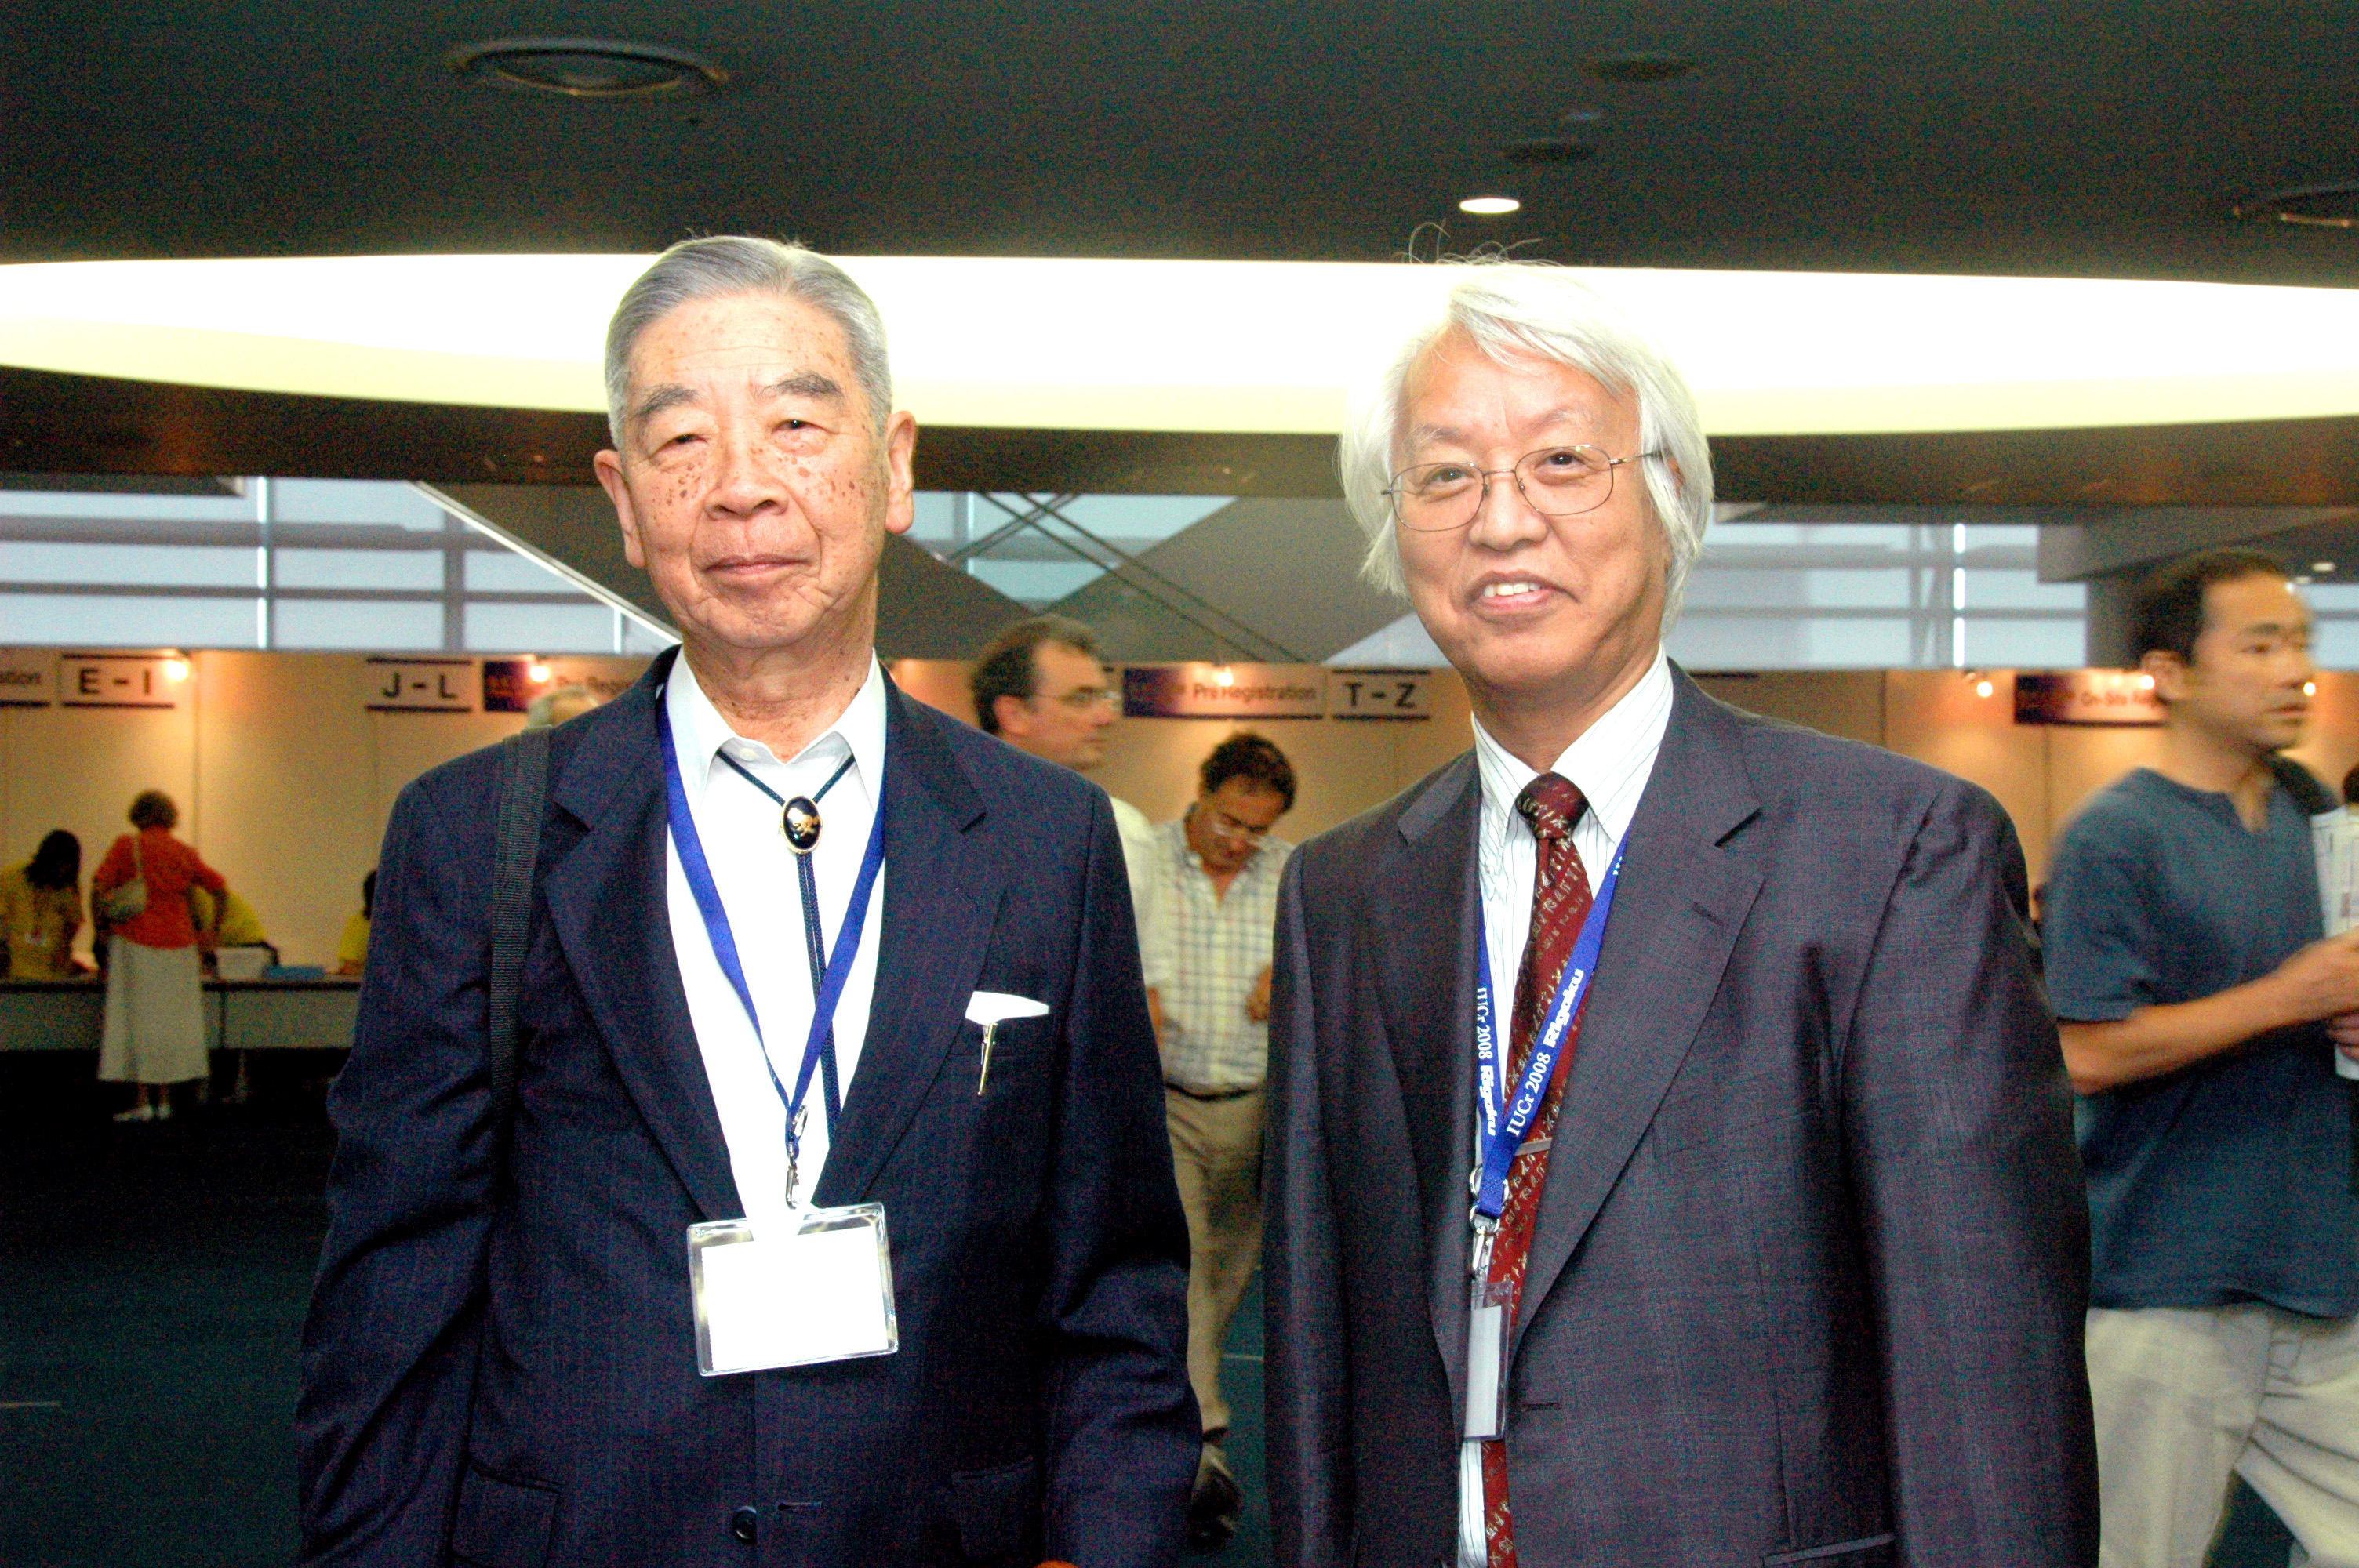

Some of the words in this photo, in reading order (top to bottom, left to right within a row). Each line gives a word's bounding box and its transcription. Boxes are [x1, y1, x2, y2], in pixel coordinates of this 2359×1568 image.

[1477, 1025, 1493, 1060] 2008
[1506, 1093, 1535, 1137] IUCr
[1525, 1052, 1550, 1094] 2008
[1543, 968, 1584, 1048] Rigaku
